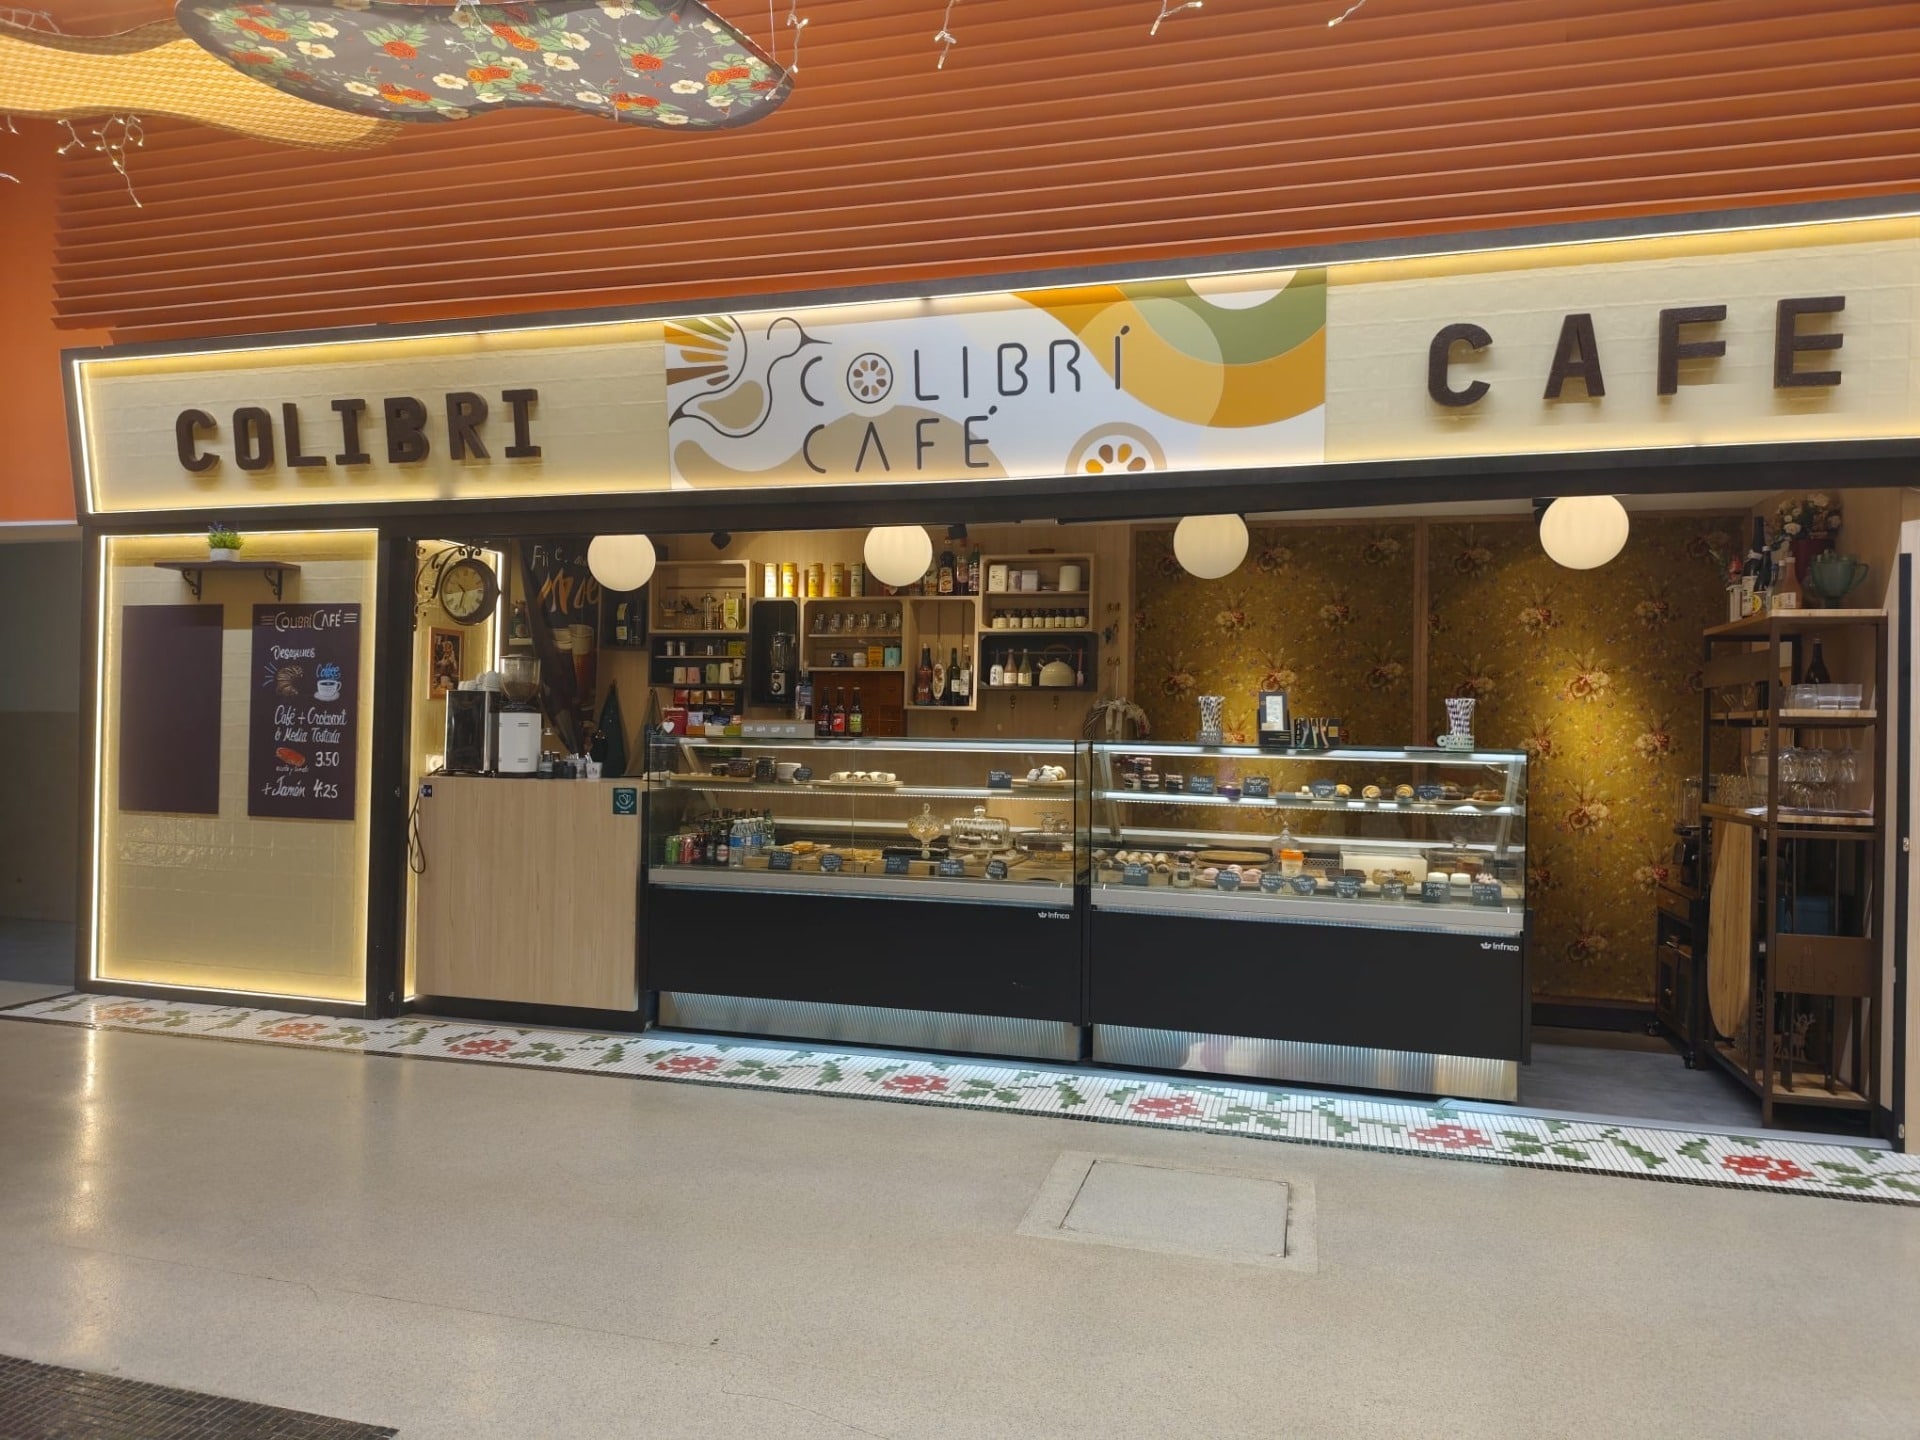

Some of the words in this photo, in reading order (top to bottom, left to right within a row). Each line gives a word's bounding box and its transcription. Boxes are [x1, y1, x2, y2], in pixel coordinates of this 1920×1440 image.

[799, 325, 1131, 408] COLIBRÍ
[1427, 296, 1846, 407] CAFE
[175, 388, 542, 473] COLIBRI
[803, 405, 998, 474] CAFÉ
